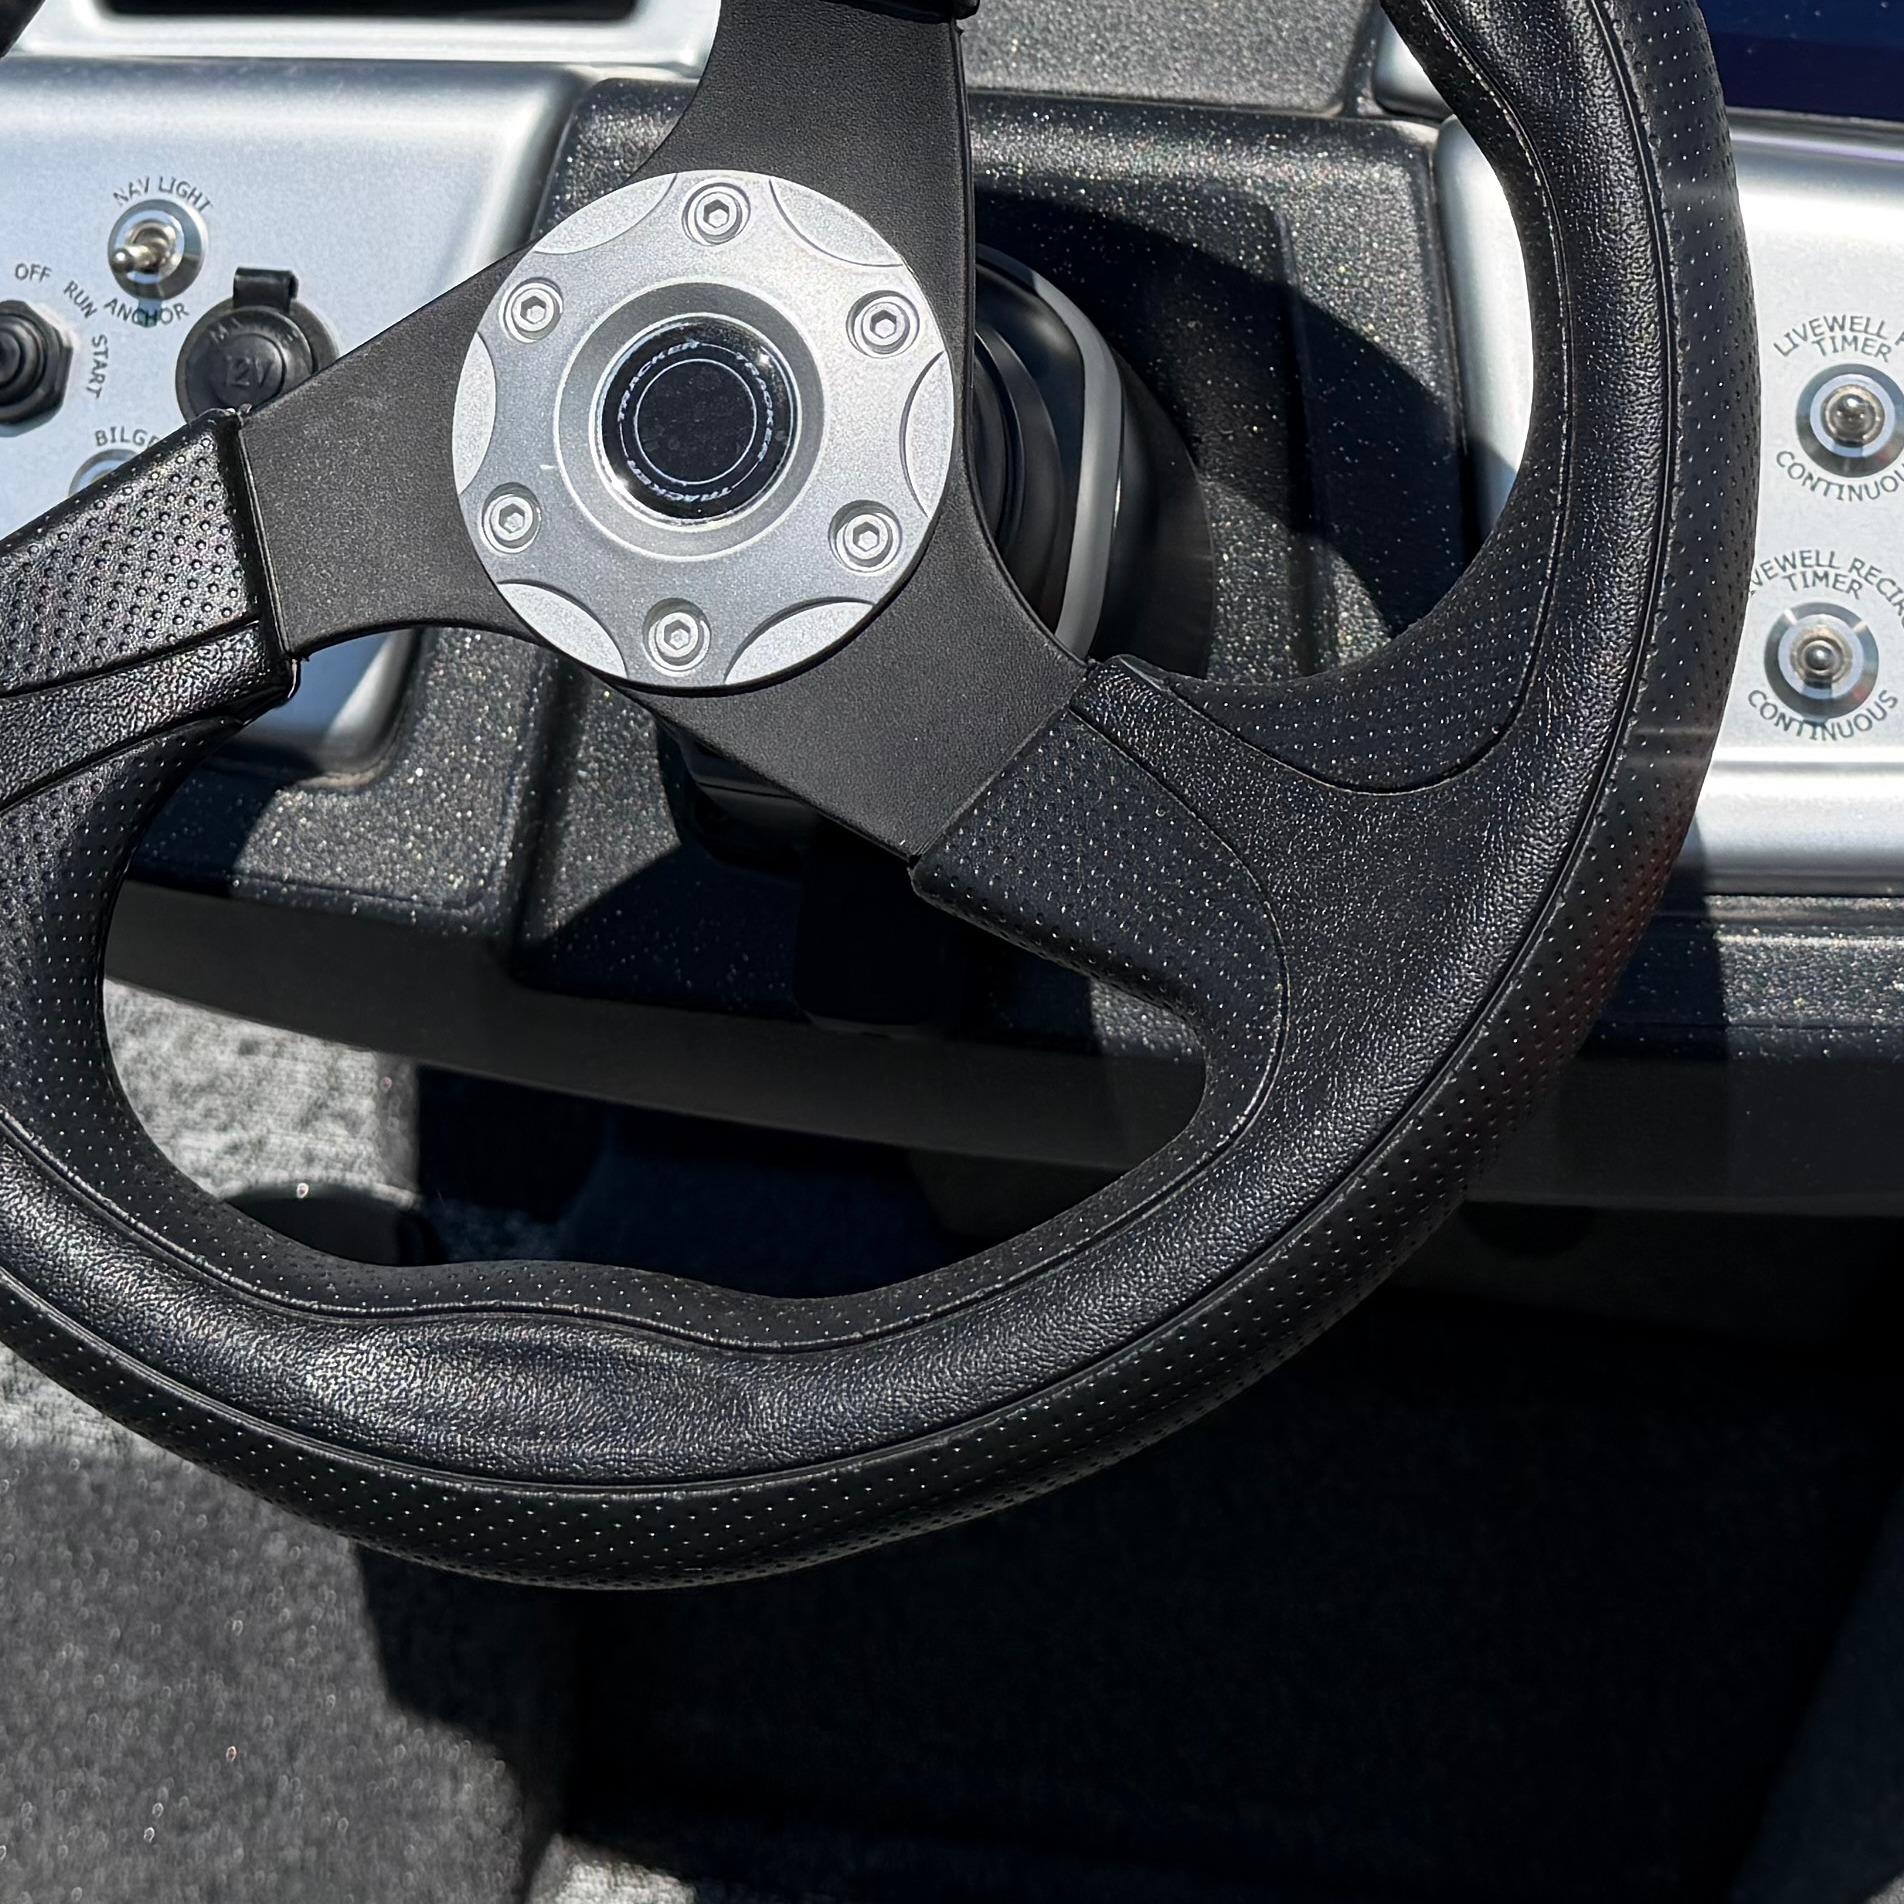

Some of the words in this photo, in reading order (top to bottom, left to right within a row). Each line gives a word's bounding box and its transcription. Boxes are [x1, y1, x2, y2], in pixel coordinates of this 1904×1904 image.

[112, 176, 150, 207] NAV
[158, 176, 214, 213] LIGHT
[14, 263, 52, 282] OFF
[63, 280, 98, 319] RUN
[103, 297, 190, 326] ANCHOR
[1773, 314, 1888, 358] LIVEWELL
[1811, 335, 1893, 363] TIMER
[85, 334, 110, 400] START
[617, 338, 700, 423] TRACKER
[735, 351, 774, 463] TRACKER
[1750, 549, 1841, 590] VEWELL
[1781, 570, 1866, 600] TIMER
[1747, 689, 1899, 742] CONTINUOUS
